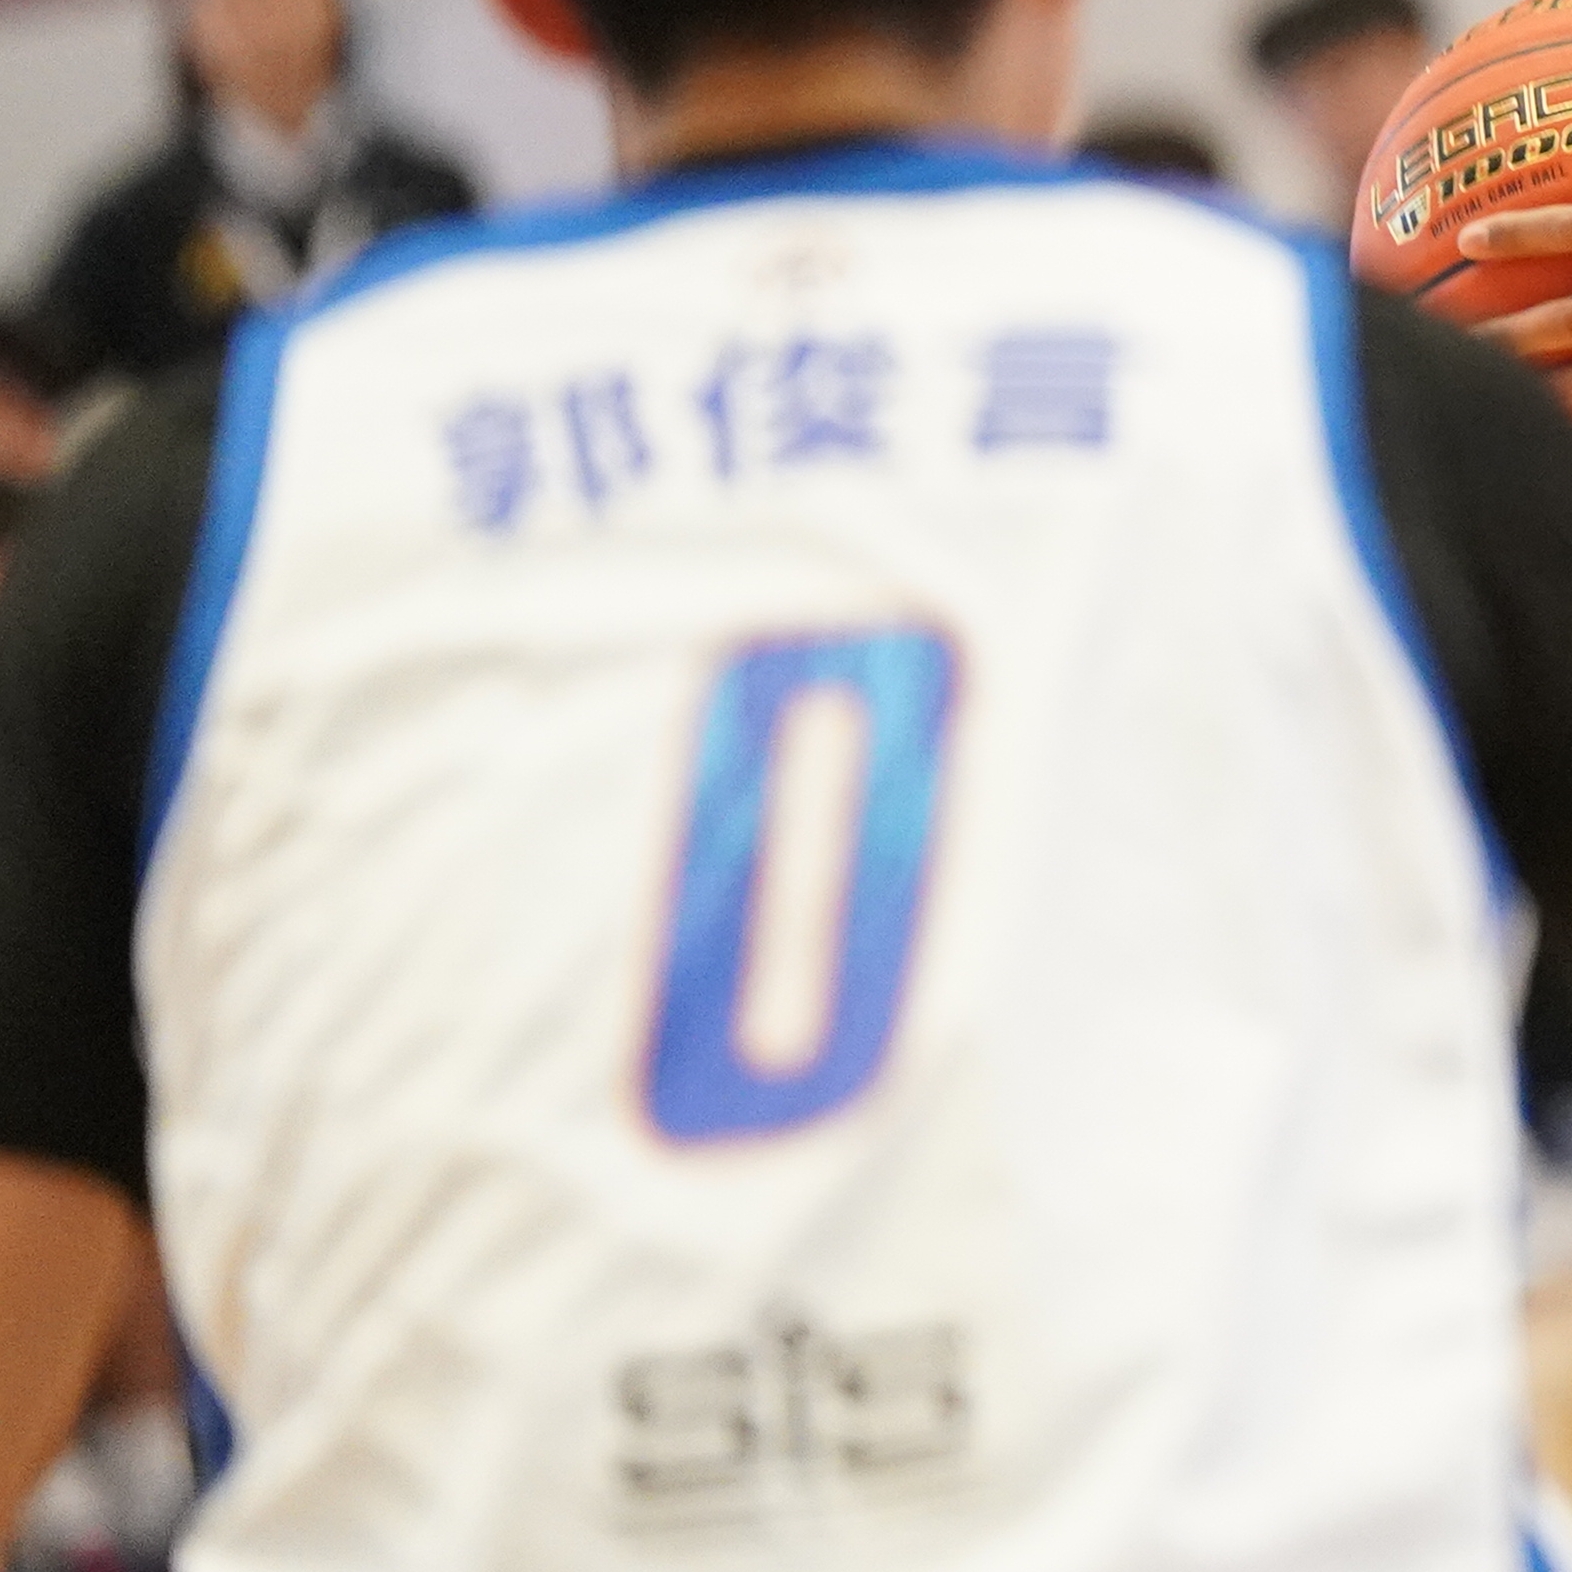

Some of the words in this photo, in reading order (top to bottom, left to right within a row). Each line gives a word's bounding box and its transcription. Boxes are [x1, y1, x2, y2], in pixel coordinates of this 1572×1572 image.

[1487, 173, 1525, 205] GAME
[1530, 162, 1567, 188] BALL
[638, 615, 964, 1152] 0
